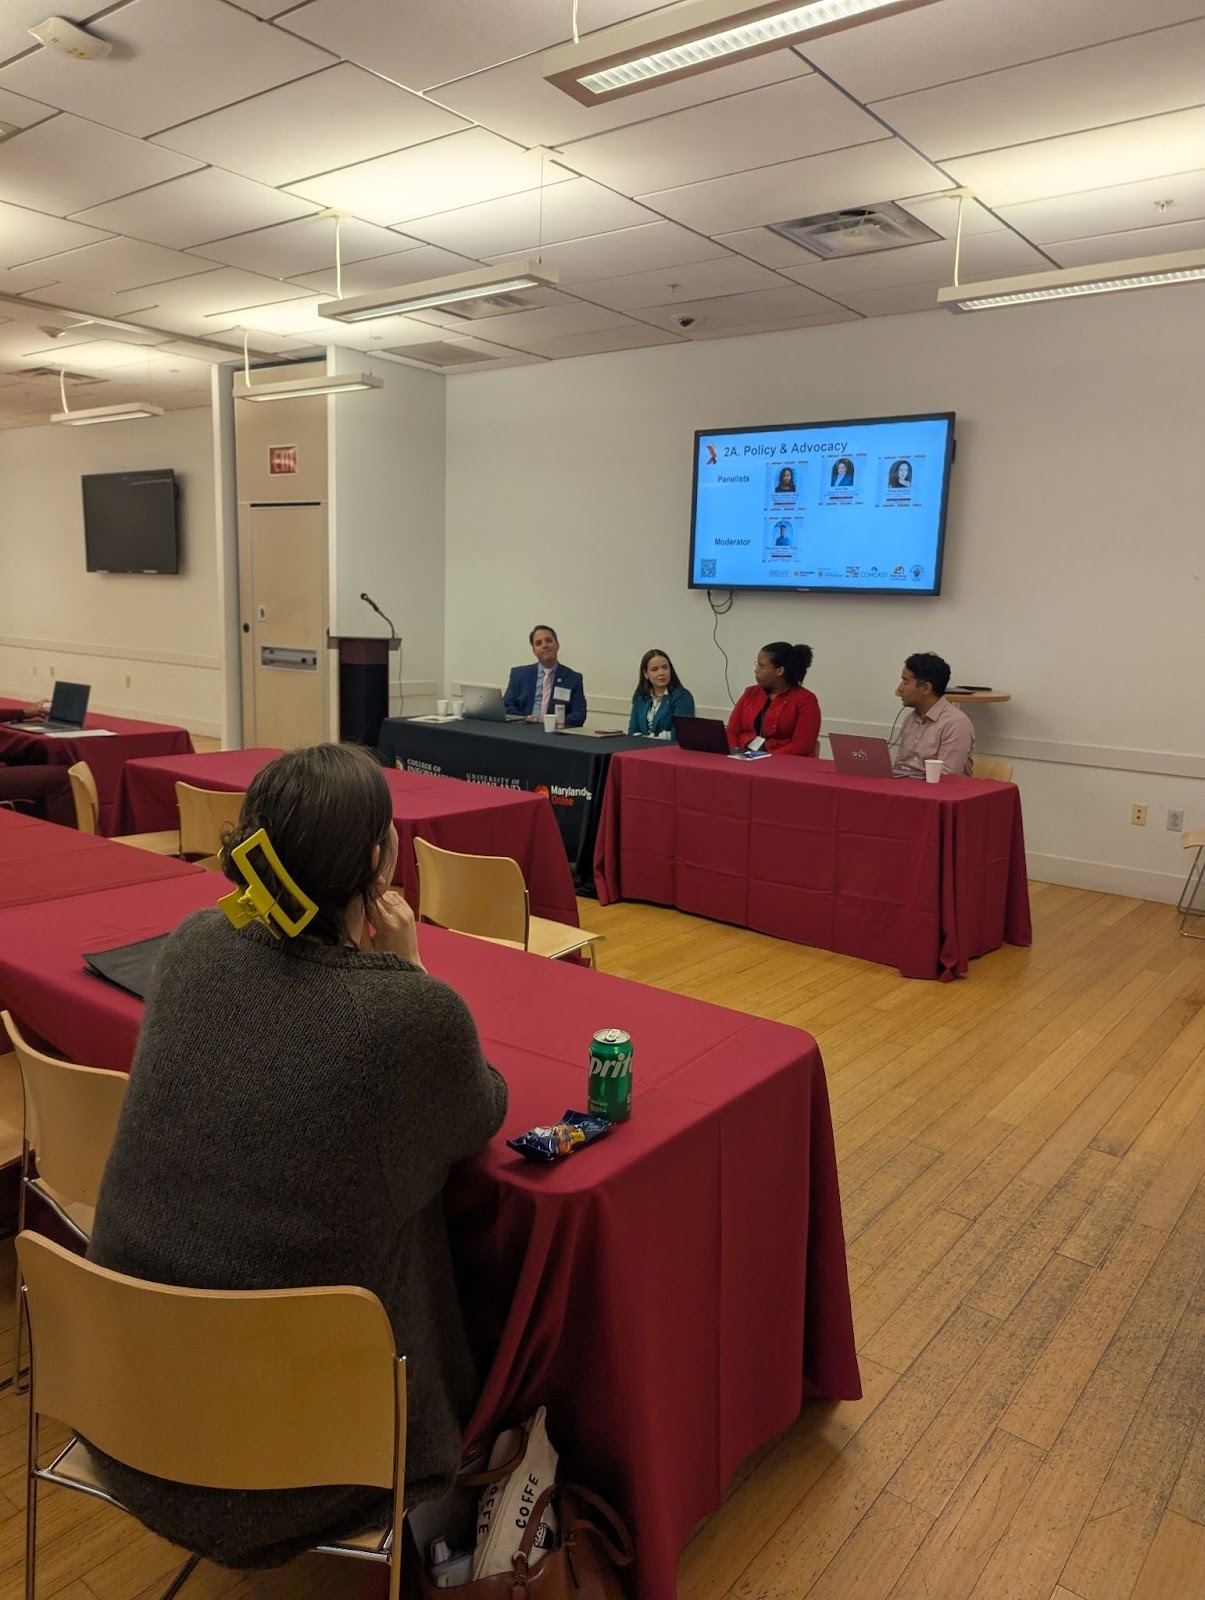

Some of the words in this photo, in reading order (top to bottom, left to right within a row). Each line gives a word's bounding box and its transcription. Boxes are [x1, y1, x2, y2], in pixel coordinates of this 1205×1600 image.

[723, 446, 741, 457] 2A.
[743, 444, 776, 458] Policy
[779, 443, 788, 454] &
[790, 441, 848, 454] Advocacy
[717, 475, 750, 483] Panelists
[714, 538, 751, 546] Moderator
[406, 758, 432, 771] COLLEGE
[466, 772, 509, 784] UNIVERSITY
[550, 785, 593, 801] Maryland's
[589, 1047, 633, 1078] prit
